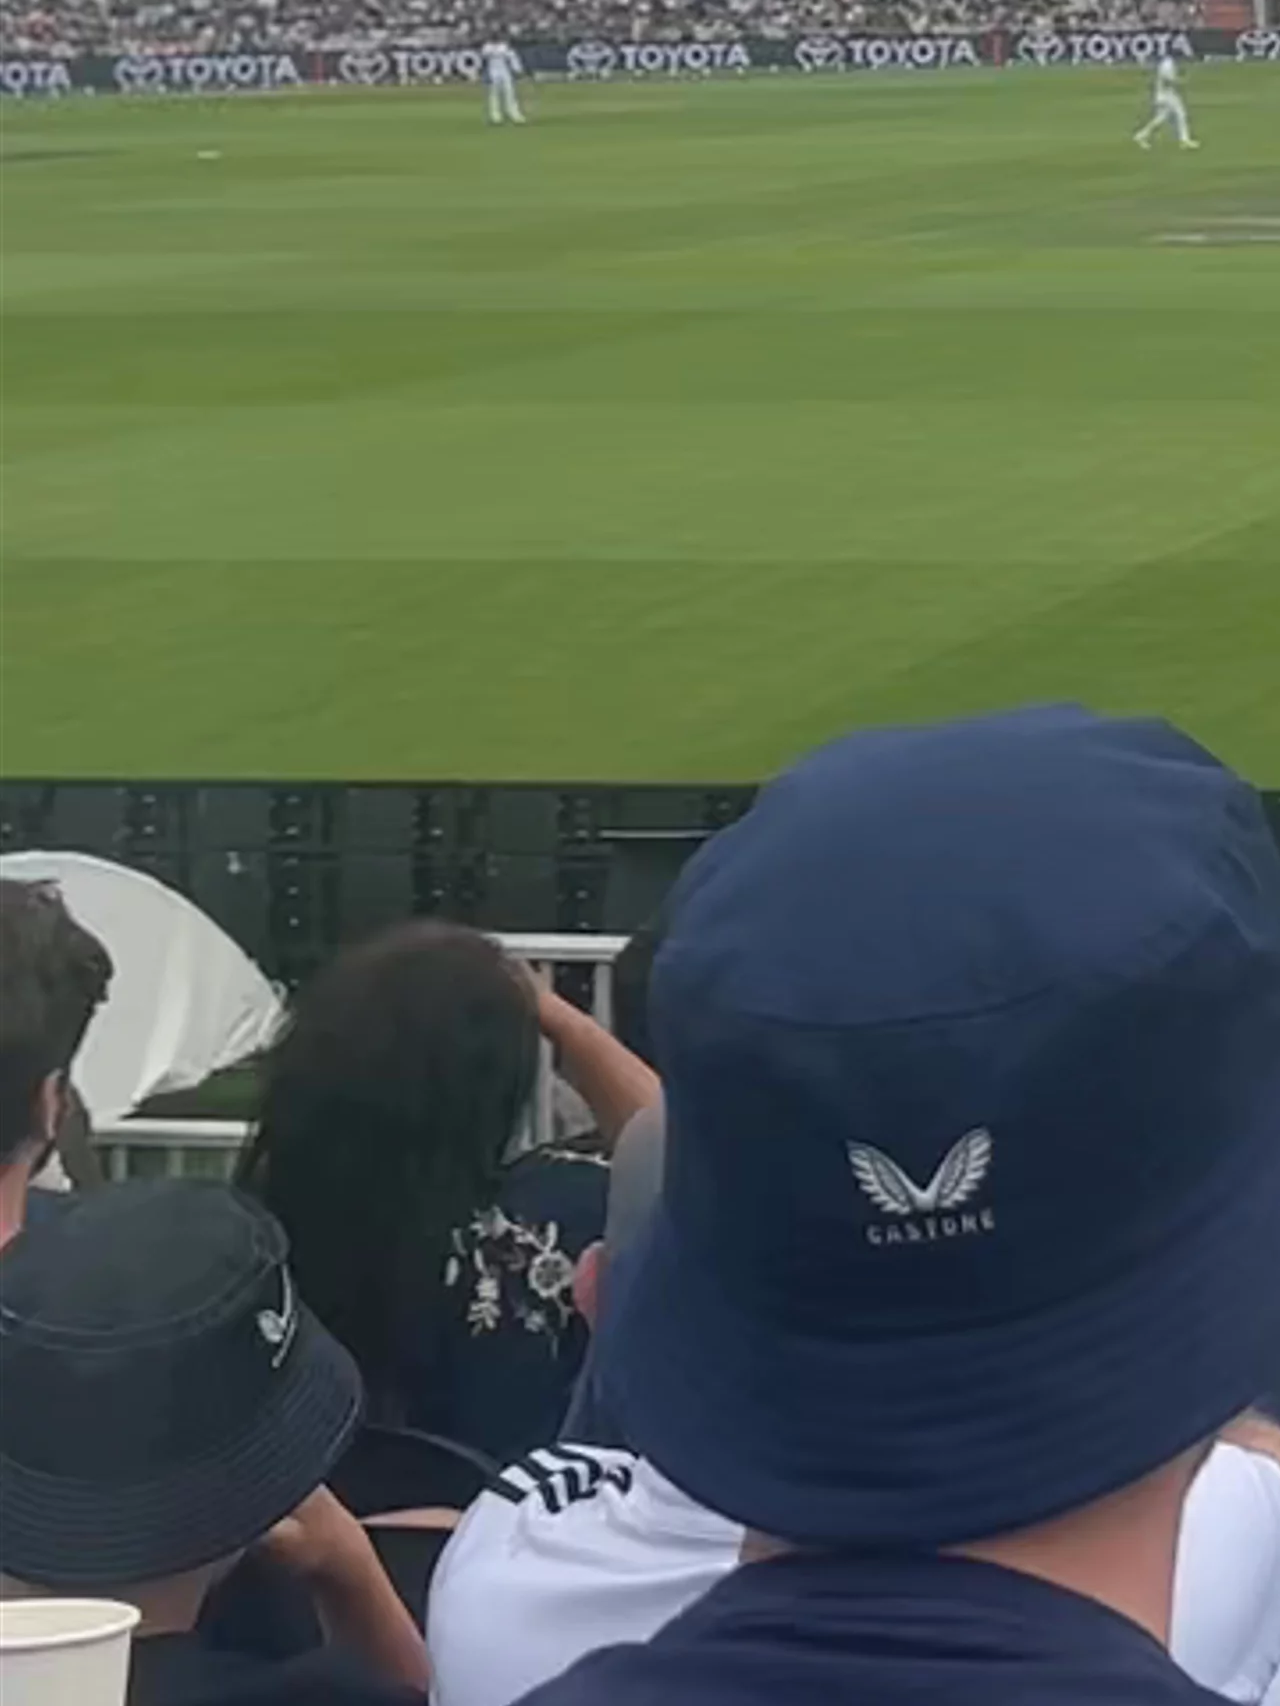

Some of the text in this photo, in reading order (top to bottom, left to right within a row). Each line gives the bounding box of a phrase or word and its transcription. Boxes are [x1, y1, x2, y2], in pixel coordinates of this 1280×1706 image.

[620, 43, 751, 67] TOYOTA
[846, 40, 978, 66] TOYOTA
[1069, 33, 1192, 59] TOYOTA
[165, 55, 300, 85] TOYOTA
